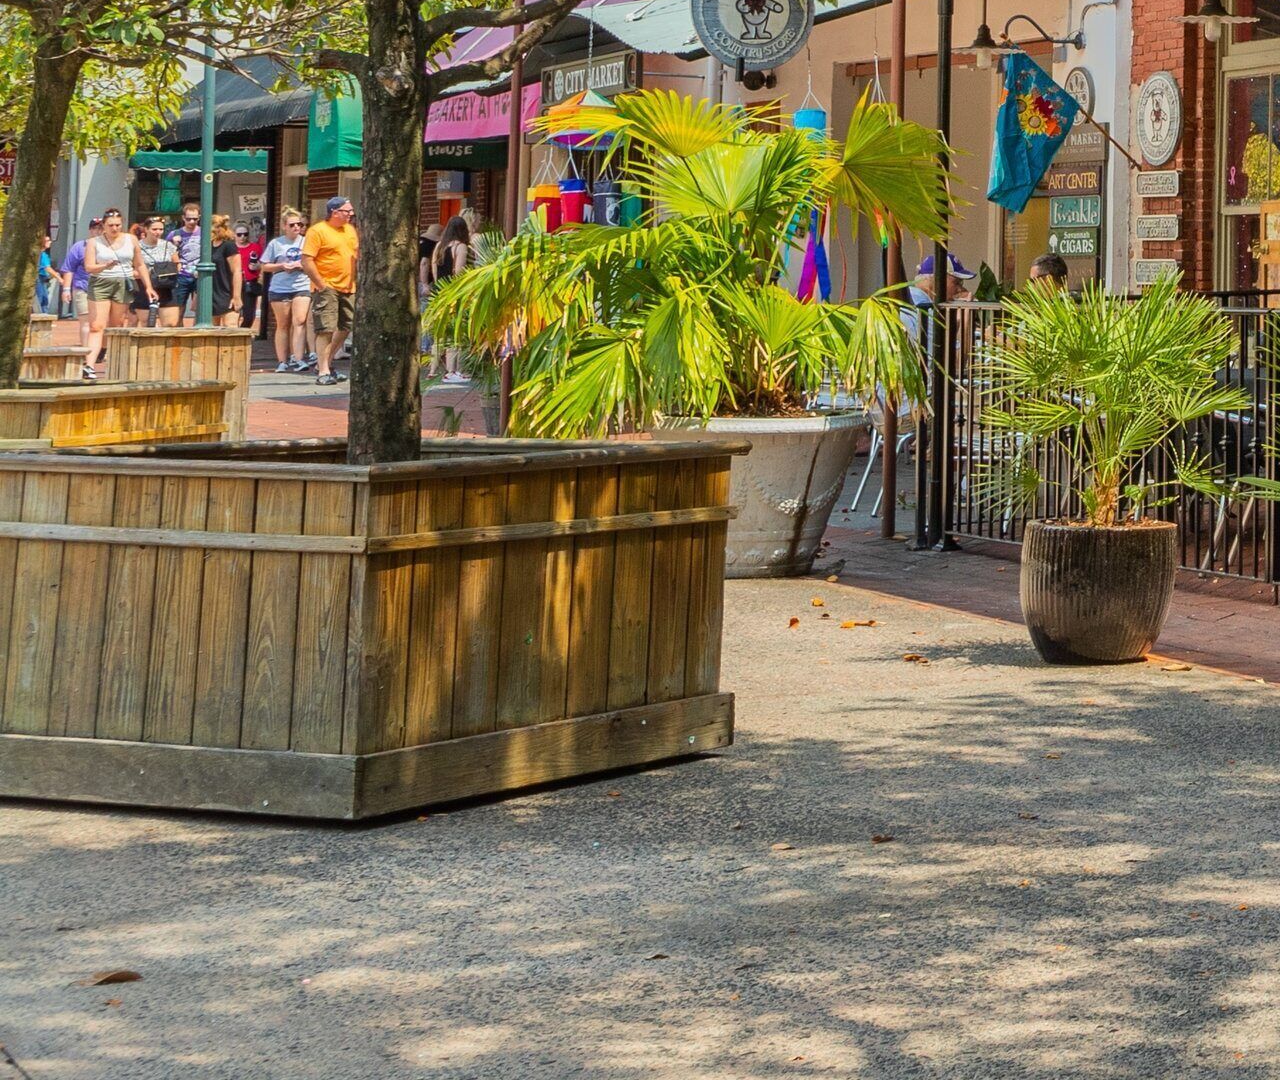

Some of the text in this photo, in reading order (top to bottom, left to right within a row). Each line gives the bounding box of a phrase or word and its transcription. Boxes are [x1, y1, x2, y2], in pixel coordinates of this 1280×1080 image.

[763, 27, 797, 55] STORE
[565, 61, 624, 95] CITY MARKET
[1048, 171, 1097, 190] ART CENTER
[1063, 231, 1091, 240] Savannah
[1060, 239, 1094, 254] CIGARS
